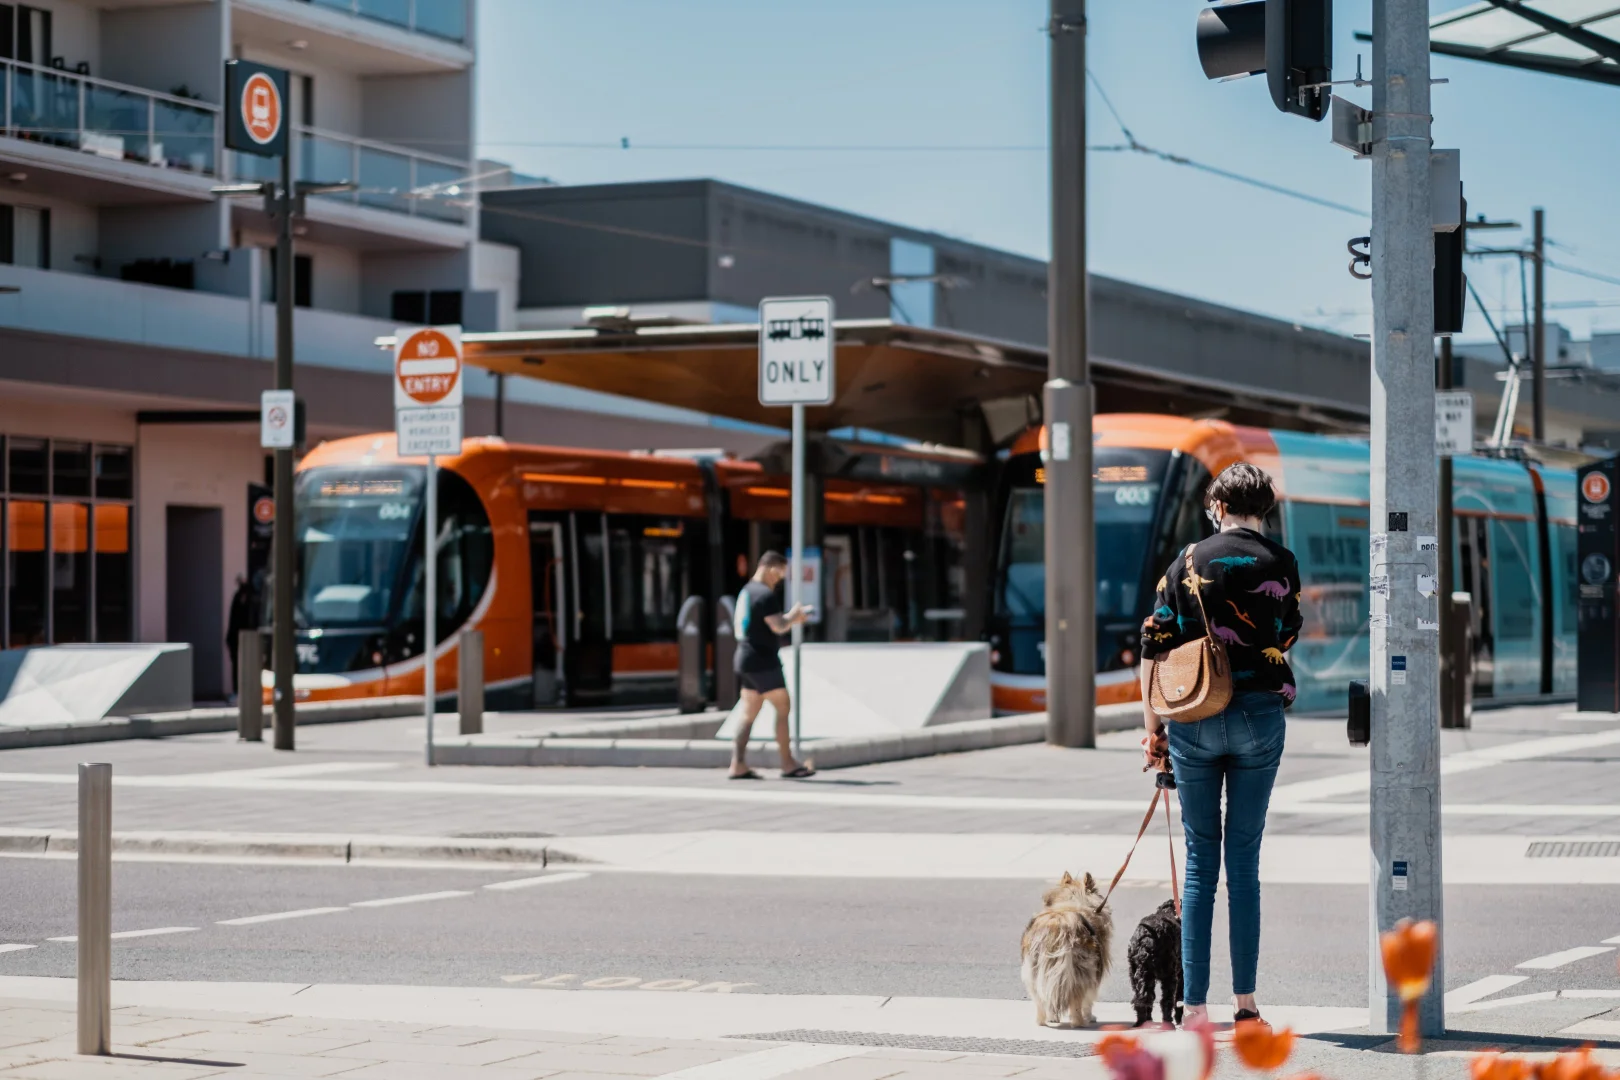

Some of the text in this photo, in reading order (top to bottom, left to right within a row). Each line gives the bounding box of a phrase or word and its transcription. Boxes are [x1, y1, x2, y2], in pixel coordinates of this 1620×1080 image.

[416, 339, 439, 358] NO
[766, 360, 825, 384] ONLY
[404, 375, 452, 394] ENTRY
[1114, 486, 1149, 505] 003
[378, 502, 411, 520] 004
[531, 973, 760, 993] LOOK
